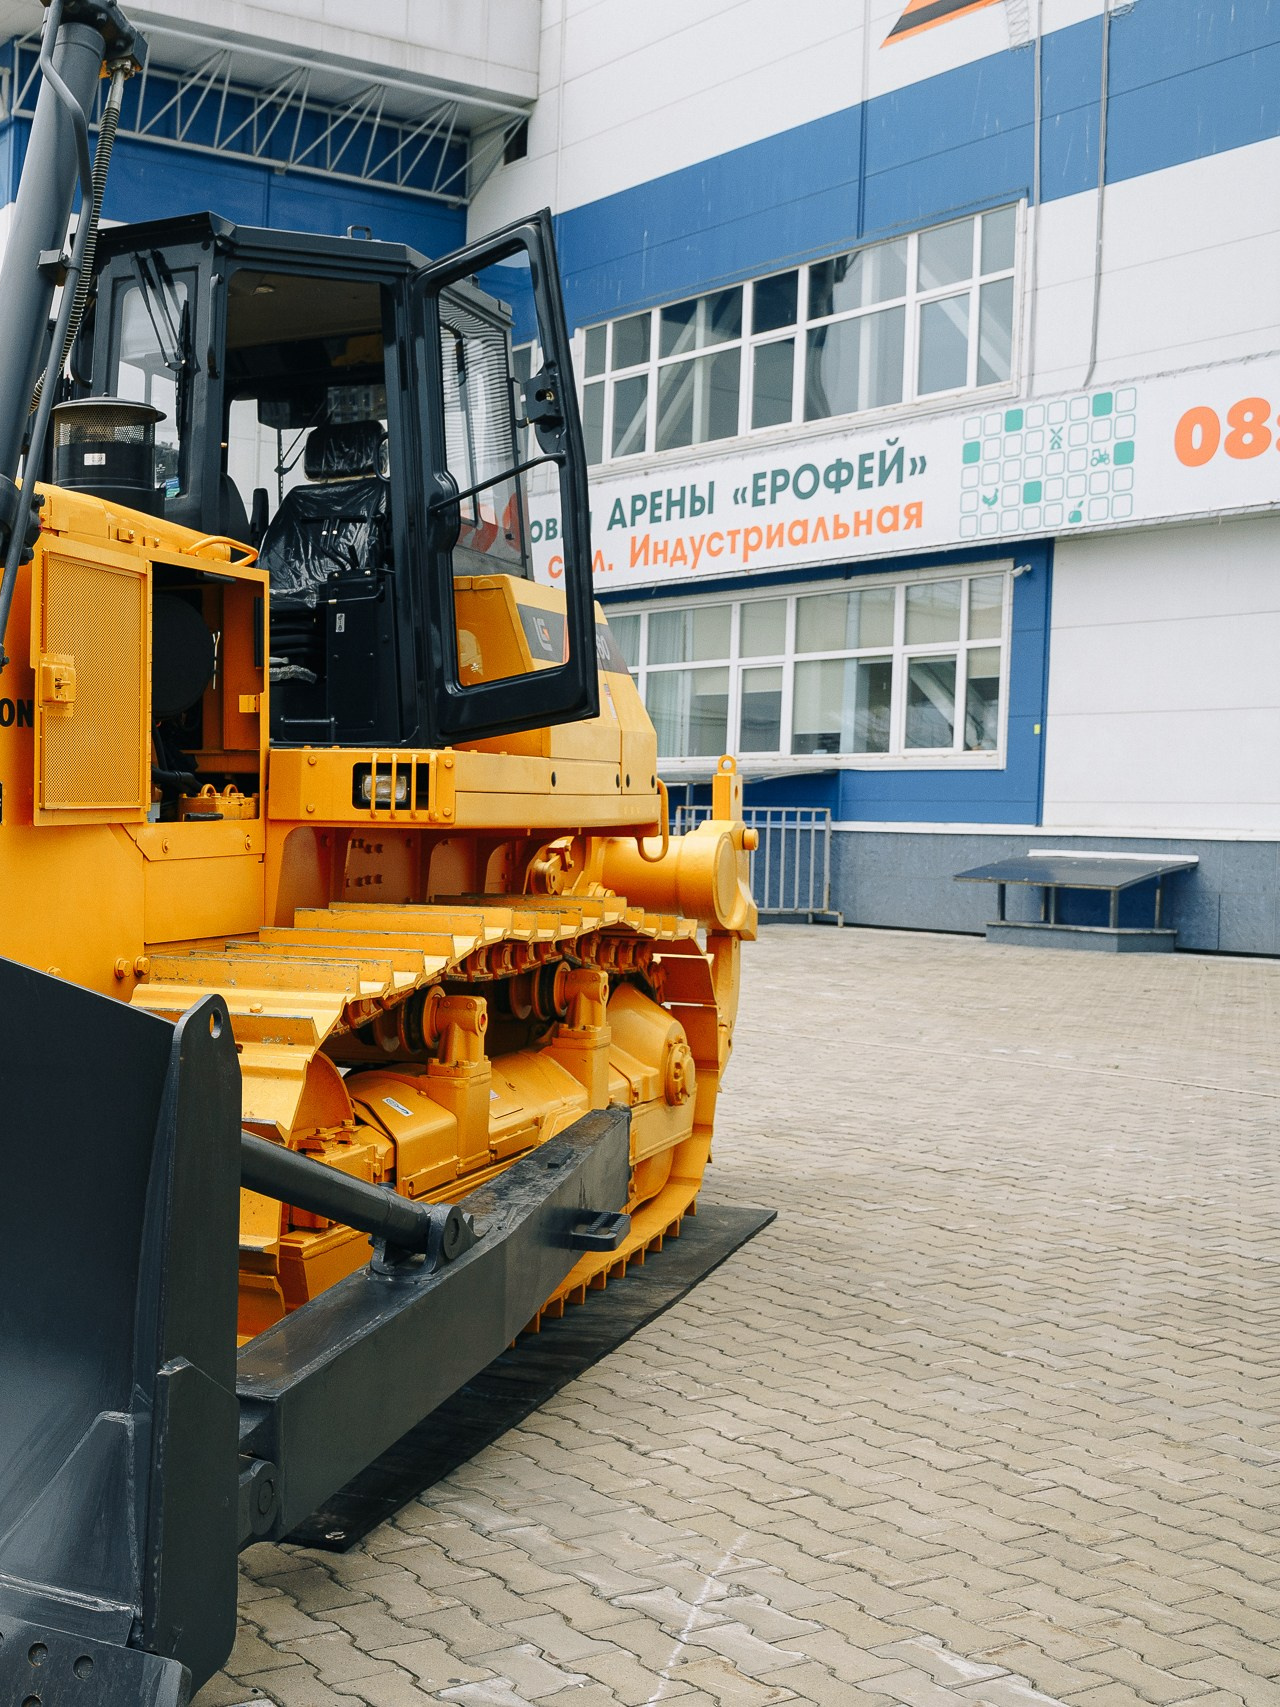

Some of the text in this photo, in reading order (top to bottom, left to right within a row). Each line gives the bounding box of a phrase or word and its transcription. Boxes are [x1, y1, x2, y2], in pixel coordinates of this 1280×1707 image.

[1174, 396, 1280, 467] 08
[607, 482, 715, 531] АРЕНЫ
[733, 437, 927, 507] «ЕРОФЕЙ»
[629, 500, 923, 570] Индустриальная
